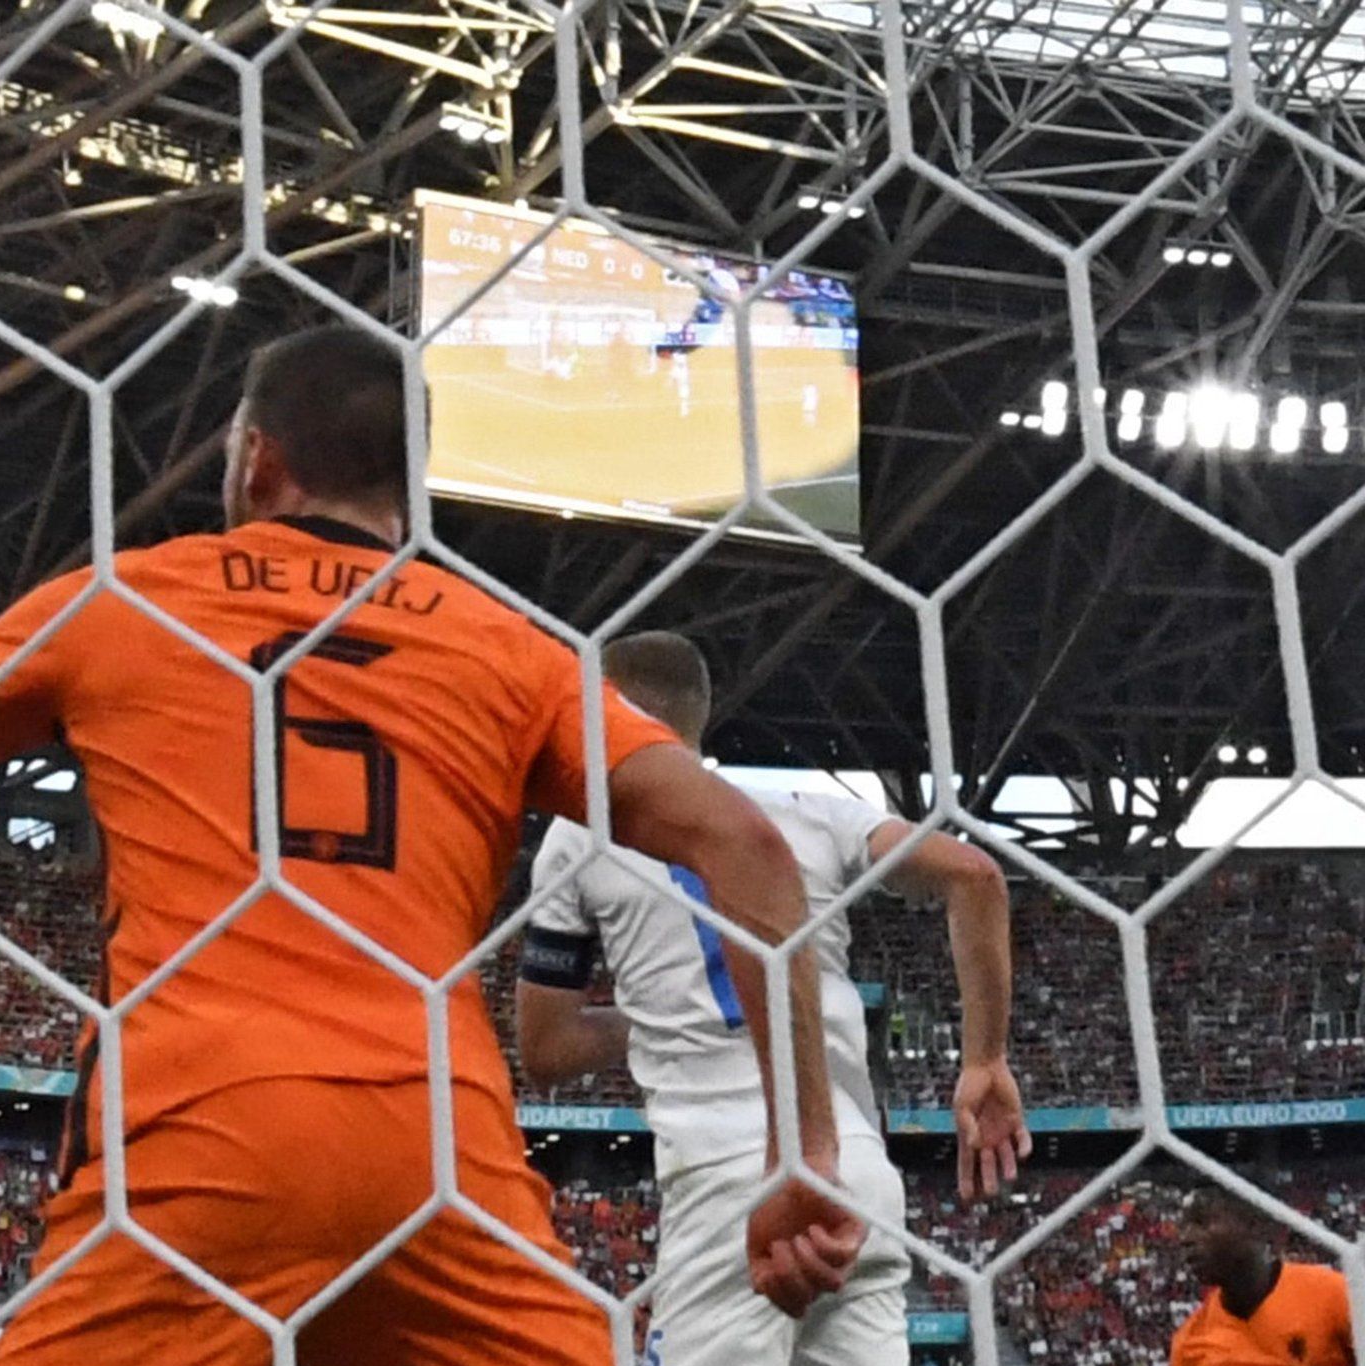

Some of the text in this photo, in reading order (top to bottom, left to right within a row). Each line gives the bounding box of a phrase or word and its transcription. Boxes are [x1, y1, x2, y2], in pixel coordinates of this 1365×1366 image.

[222, 551, 290, 594] DE
[250, 630, 398, 872] 6
[516, 1105, 610, 1129] UDAPEST
[1173, 1102, 1347, 1127] UEFA EURO 2020
